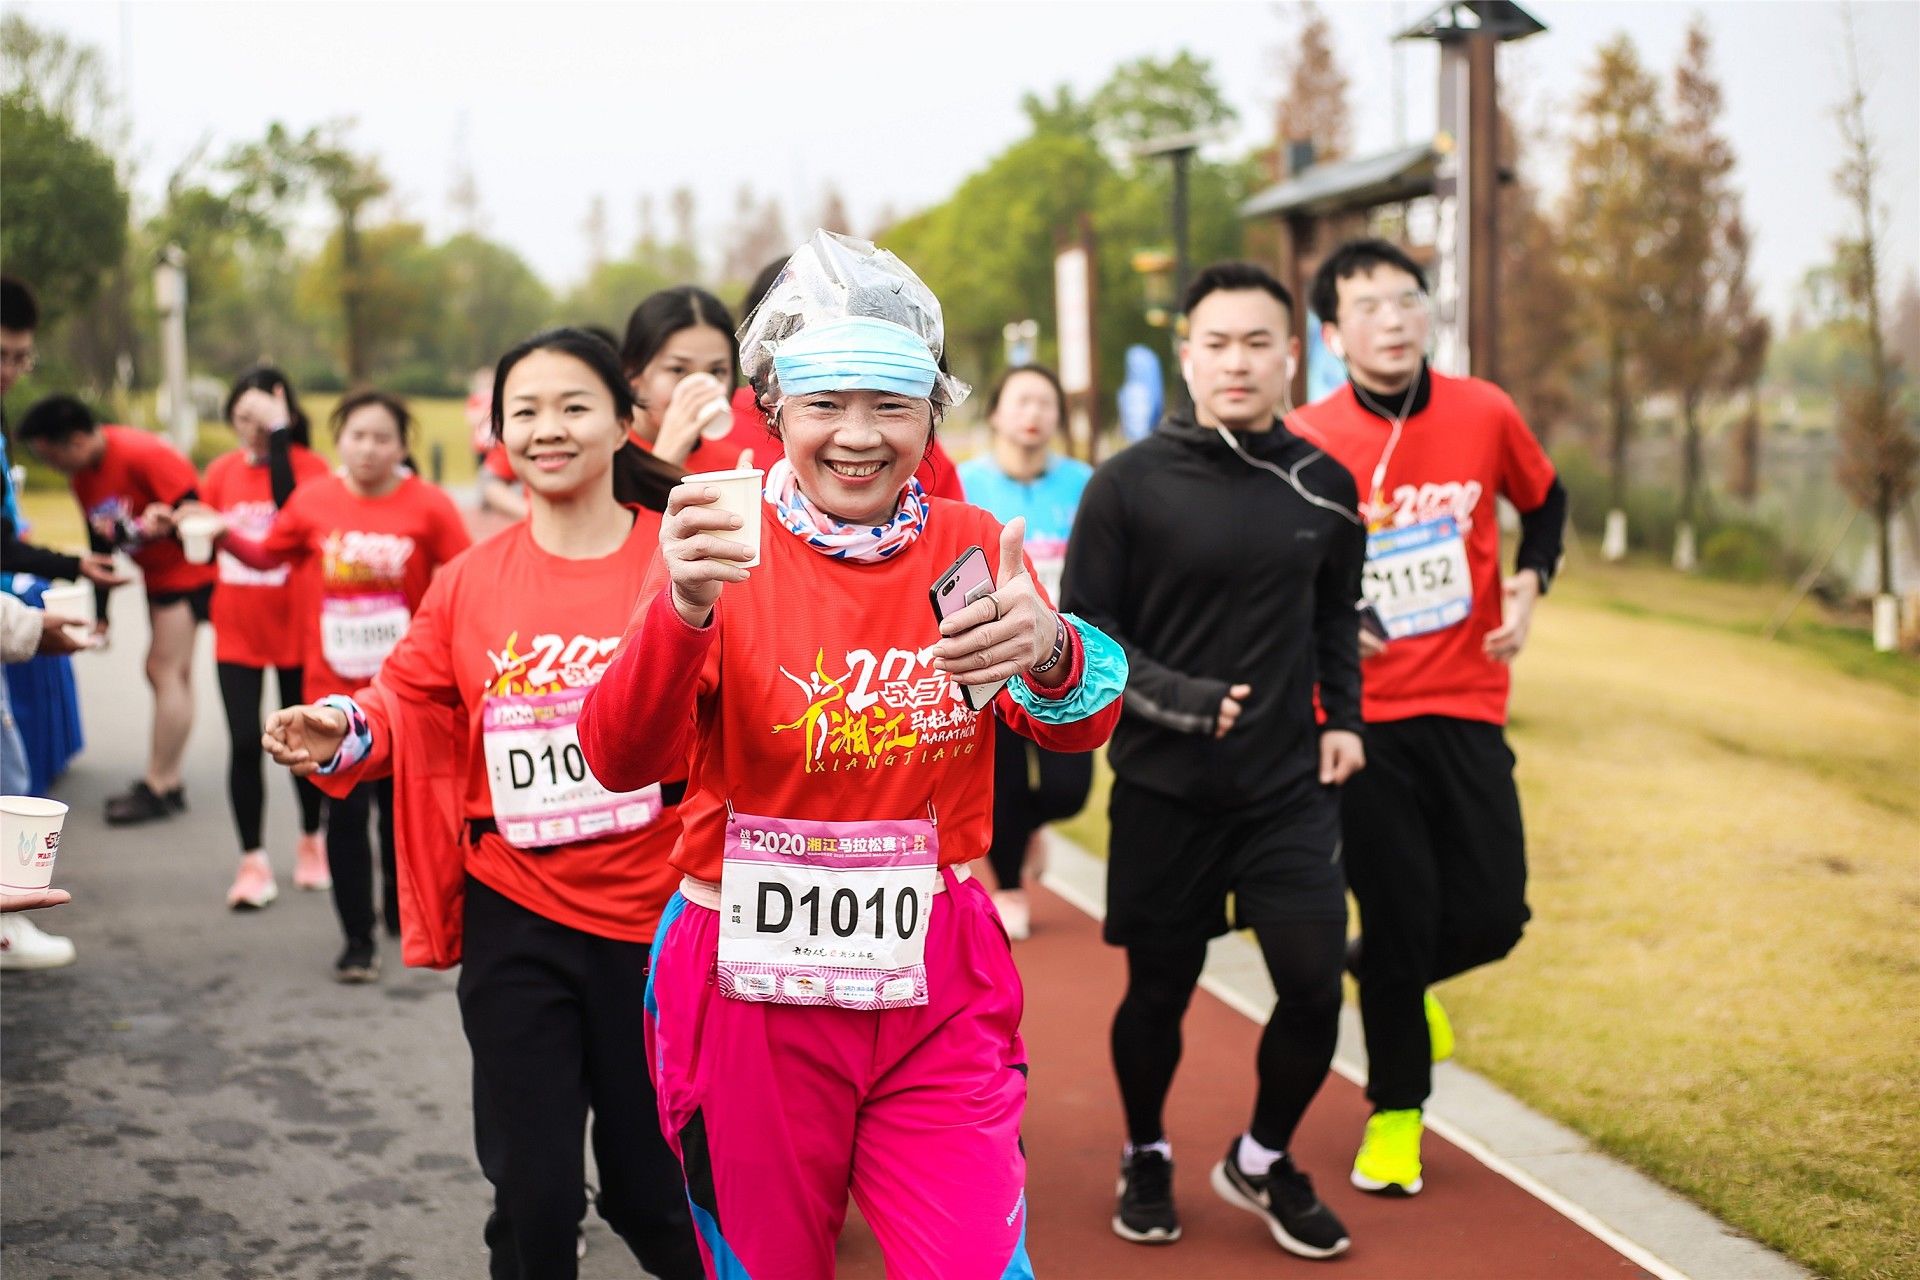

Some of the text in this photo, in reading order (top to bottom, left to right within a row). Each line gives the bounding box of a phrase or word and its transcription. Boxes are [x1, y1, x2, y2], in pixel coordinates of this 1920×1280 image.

[828, 705, 918, 756] 湘江
[508, 742, 586, 790] D10
[752, 829, 805, 857] 2020
[807, 836, 897, 853] 湘江马拉松赛
[756, 881, 919, 940] D1010
